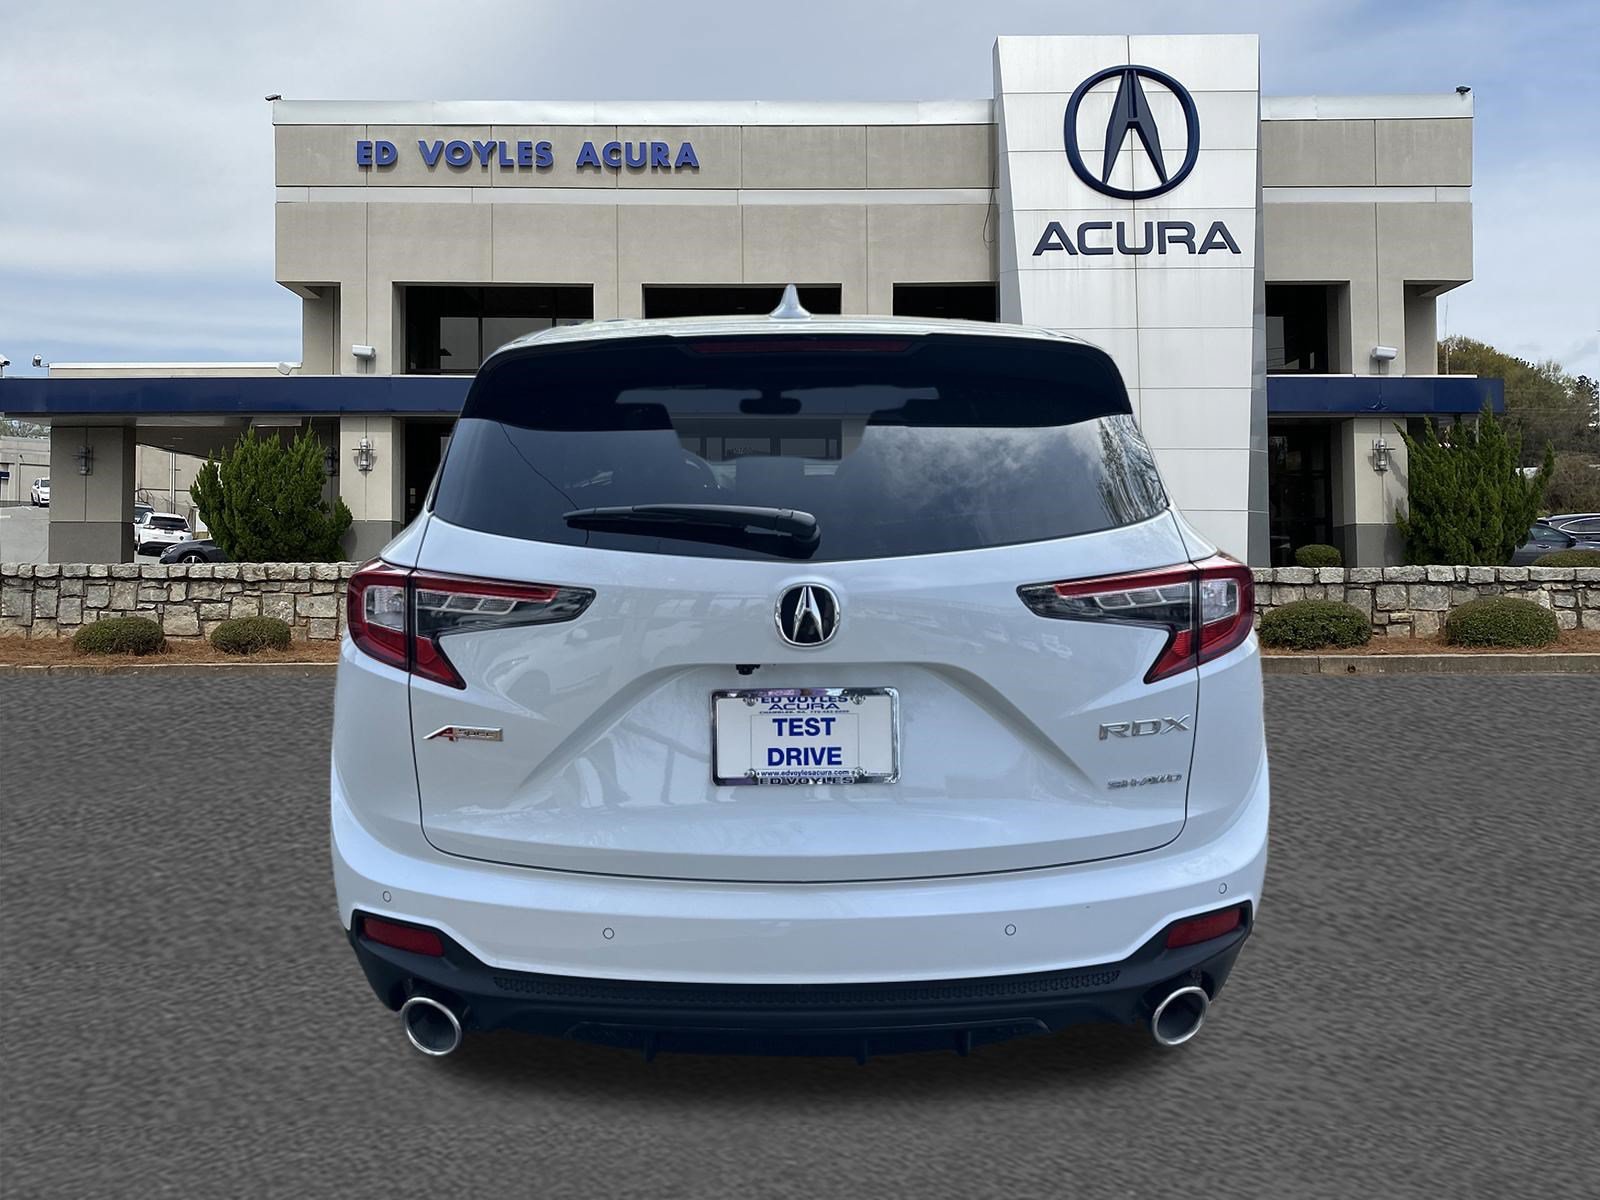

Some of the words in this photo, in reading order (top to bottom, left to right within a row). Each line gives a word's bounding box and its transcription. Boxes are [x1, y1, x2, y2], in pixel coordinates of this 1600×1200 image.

[356, 140, 398, 168] ED
[418, 140, 554, 168] VOYLES
[576, 141, 700, 168] ACURA
[1032, 221, 1242, 256] ACURA
[772, 717, 836, 736] TEST
[1099, 714, 1191, 740] RDX
[767, 747, 843, 766] DRIVE
